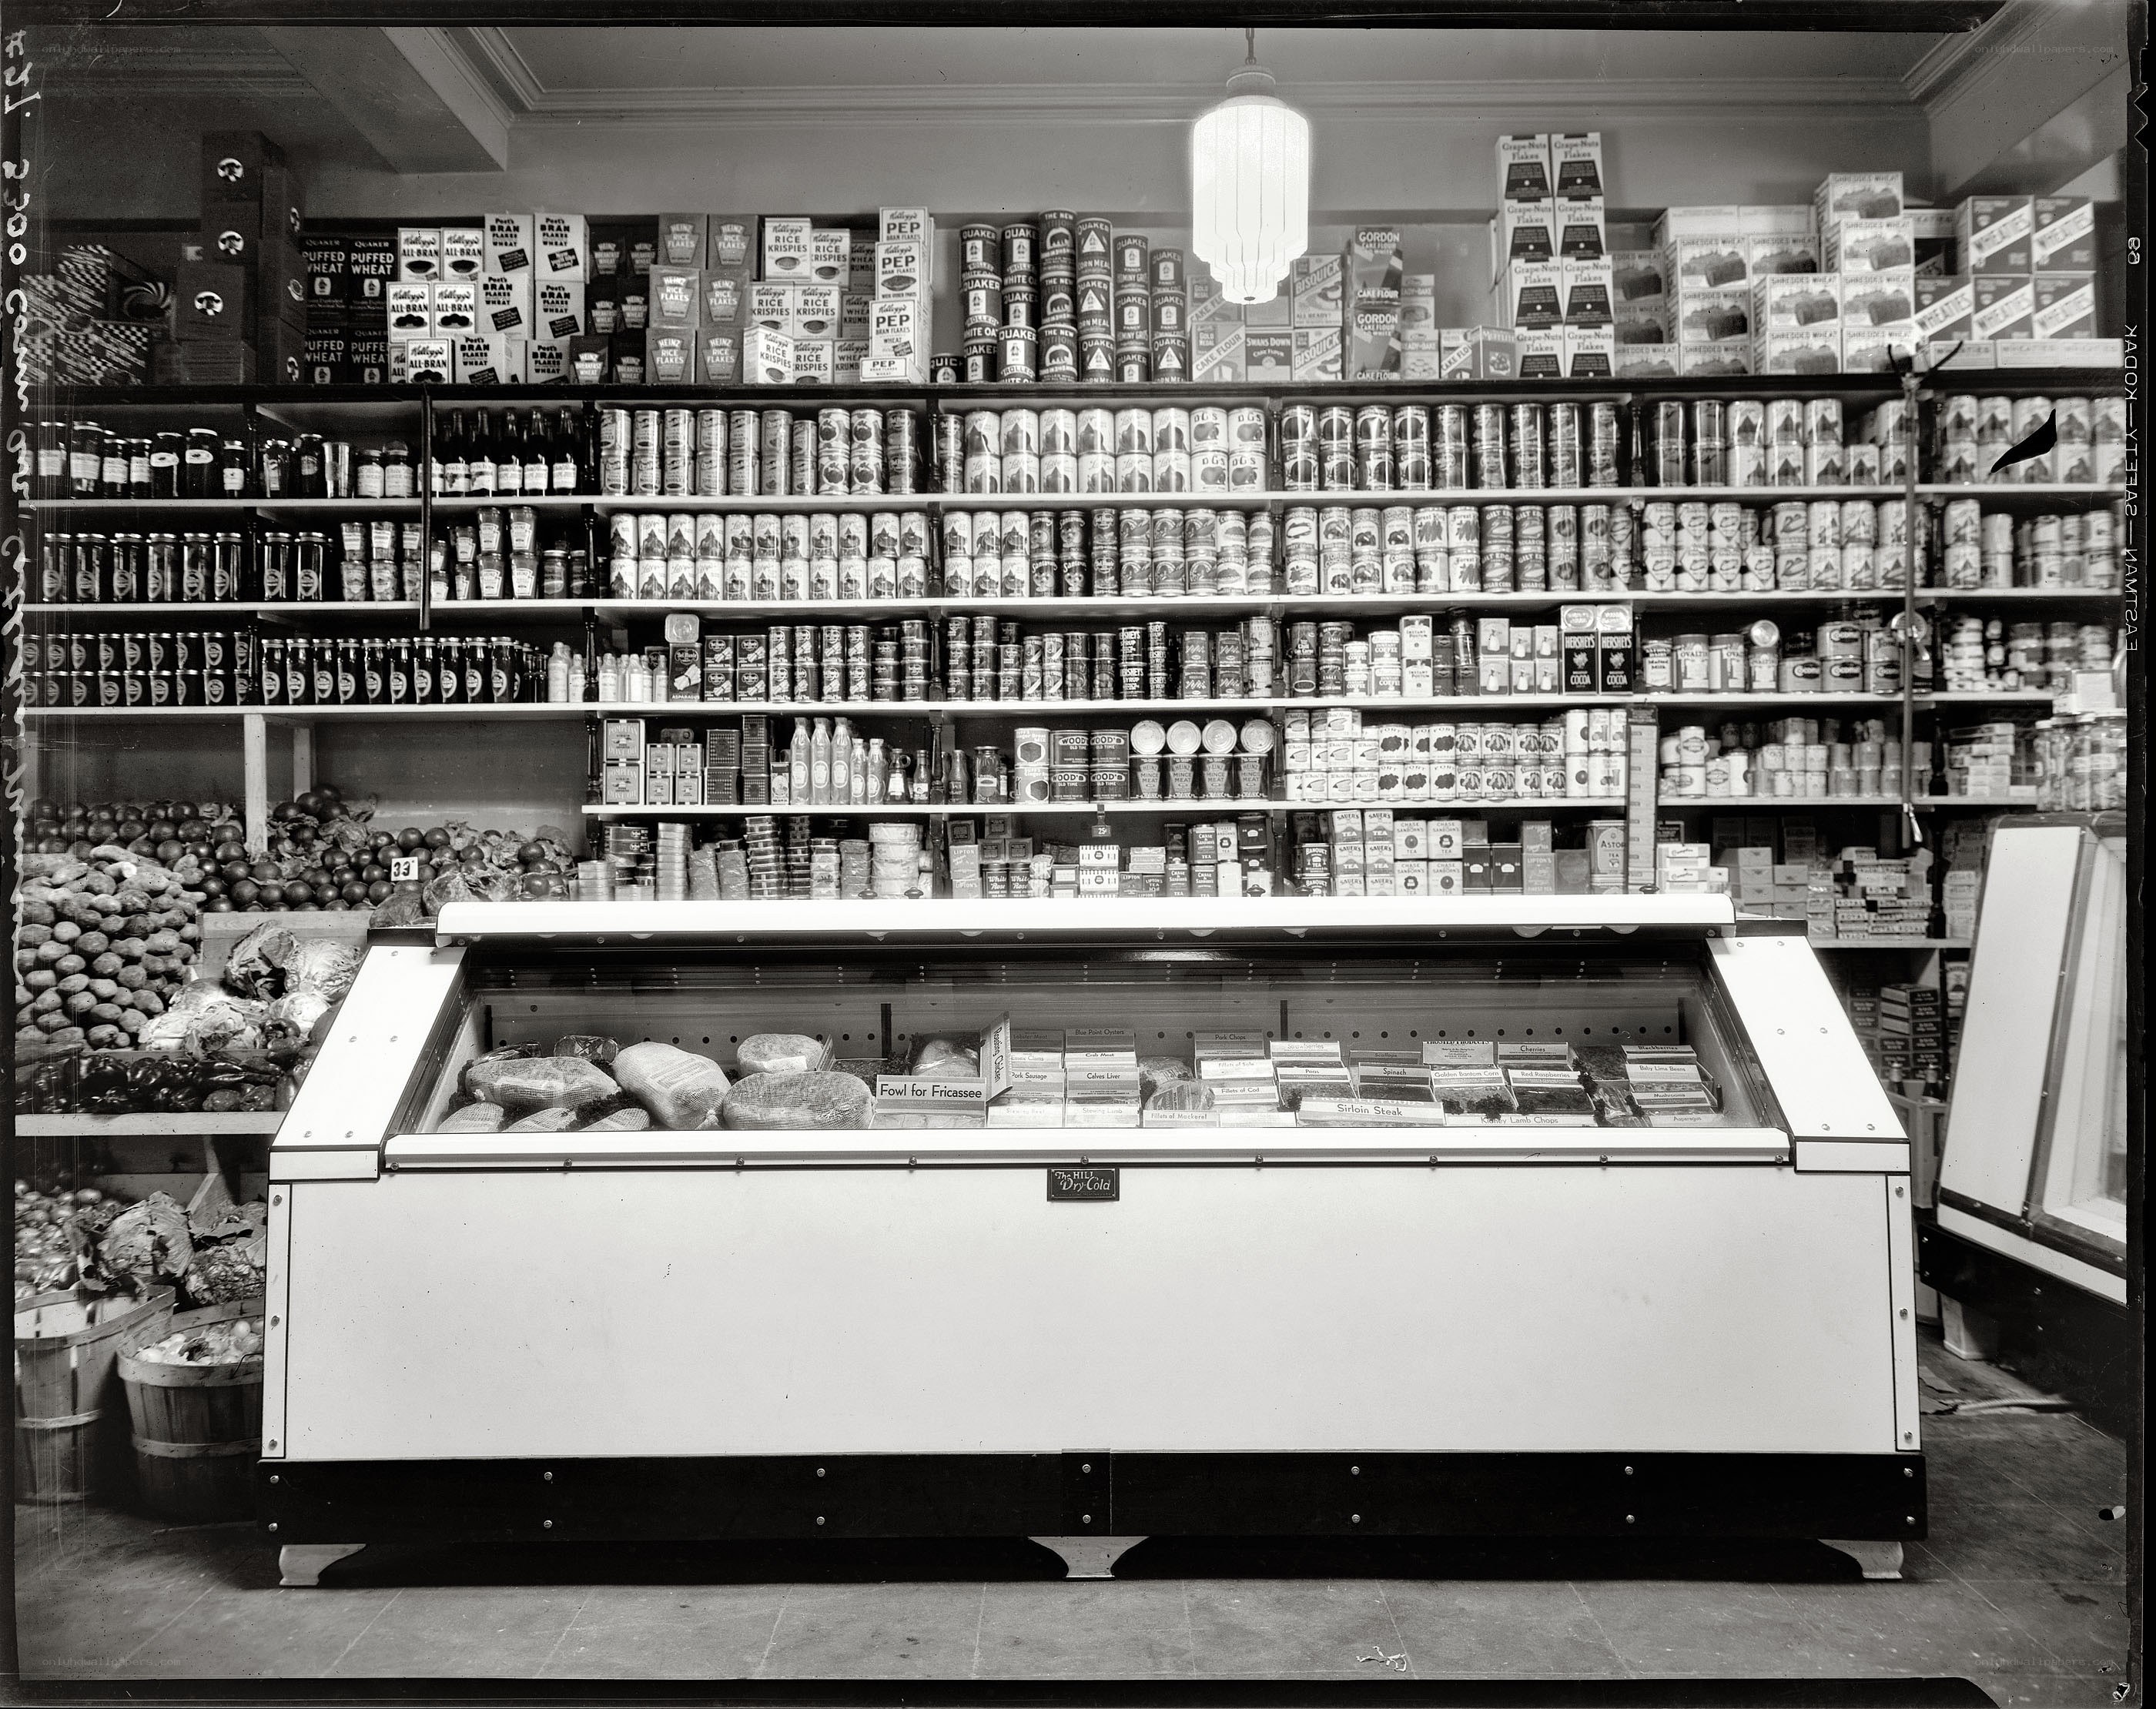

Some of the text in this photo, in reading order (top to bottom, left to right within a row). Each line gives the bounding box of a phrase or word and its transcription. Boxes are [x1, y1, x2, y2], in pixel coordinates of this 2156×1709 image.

[1502, 142, 1547, 152] Grape-Nuts
[1554, 140, 1599, 151] Grape-Nuts
[1564, 151, 1592, 159] Flakes
[1516, 215, 1545, 224] Flakes
[671, 223, 694, 232] HEINZ
[721, 224, 745, 232] HEINZ
[887, 222, 921, 233] PEP
[962, 229, 996, 239] QUAKER
[1359, 232, 1400, 242] GORDON
[402, 248, 438, 256] ALL-BRAN
[445, 248, 481, 256] ALL-BRAN
[351, 253, 394, 264] PUFFED
[882, 256, 916, 269] PEP
[1094, 260, 1110, 269] MEAL
[351, 265, 392, 275] WHEAT
[1295, 259, 1340, 295] BISQUICK
[964, 279, 1000, 291] QUAKER
[1378, 289, 1398, 298] FLOUR
[875, 315, 910, 328] PEP
[1358, 314, 1398, 324] GORDON
[1247, 337, 1269, 346] SWANS
[1196, 333, 1242, 371] CAKE FLOUR
[1294, 331, 1340, 367] BISQUICK
[1565, 634, 1595, 648] HERSHEY'S
[1602, 634, 1632, 648] HERSHEY'S
[1570, 675, 1591, 685] COCOA
[1607, 675, 1628, 685] COCOA
[993, 1027, 1003, 1083] Roasting Chicken
[880, 1084, 982, 1098] Fowl for Fricassee
[1337, 1104, 1403, 1116] Sirloin Steak
[1055, 1172, 1071, 1180] The
[1060, 1176, 1111, 1192] Dry-Cold
